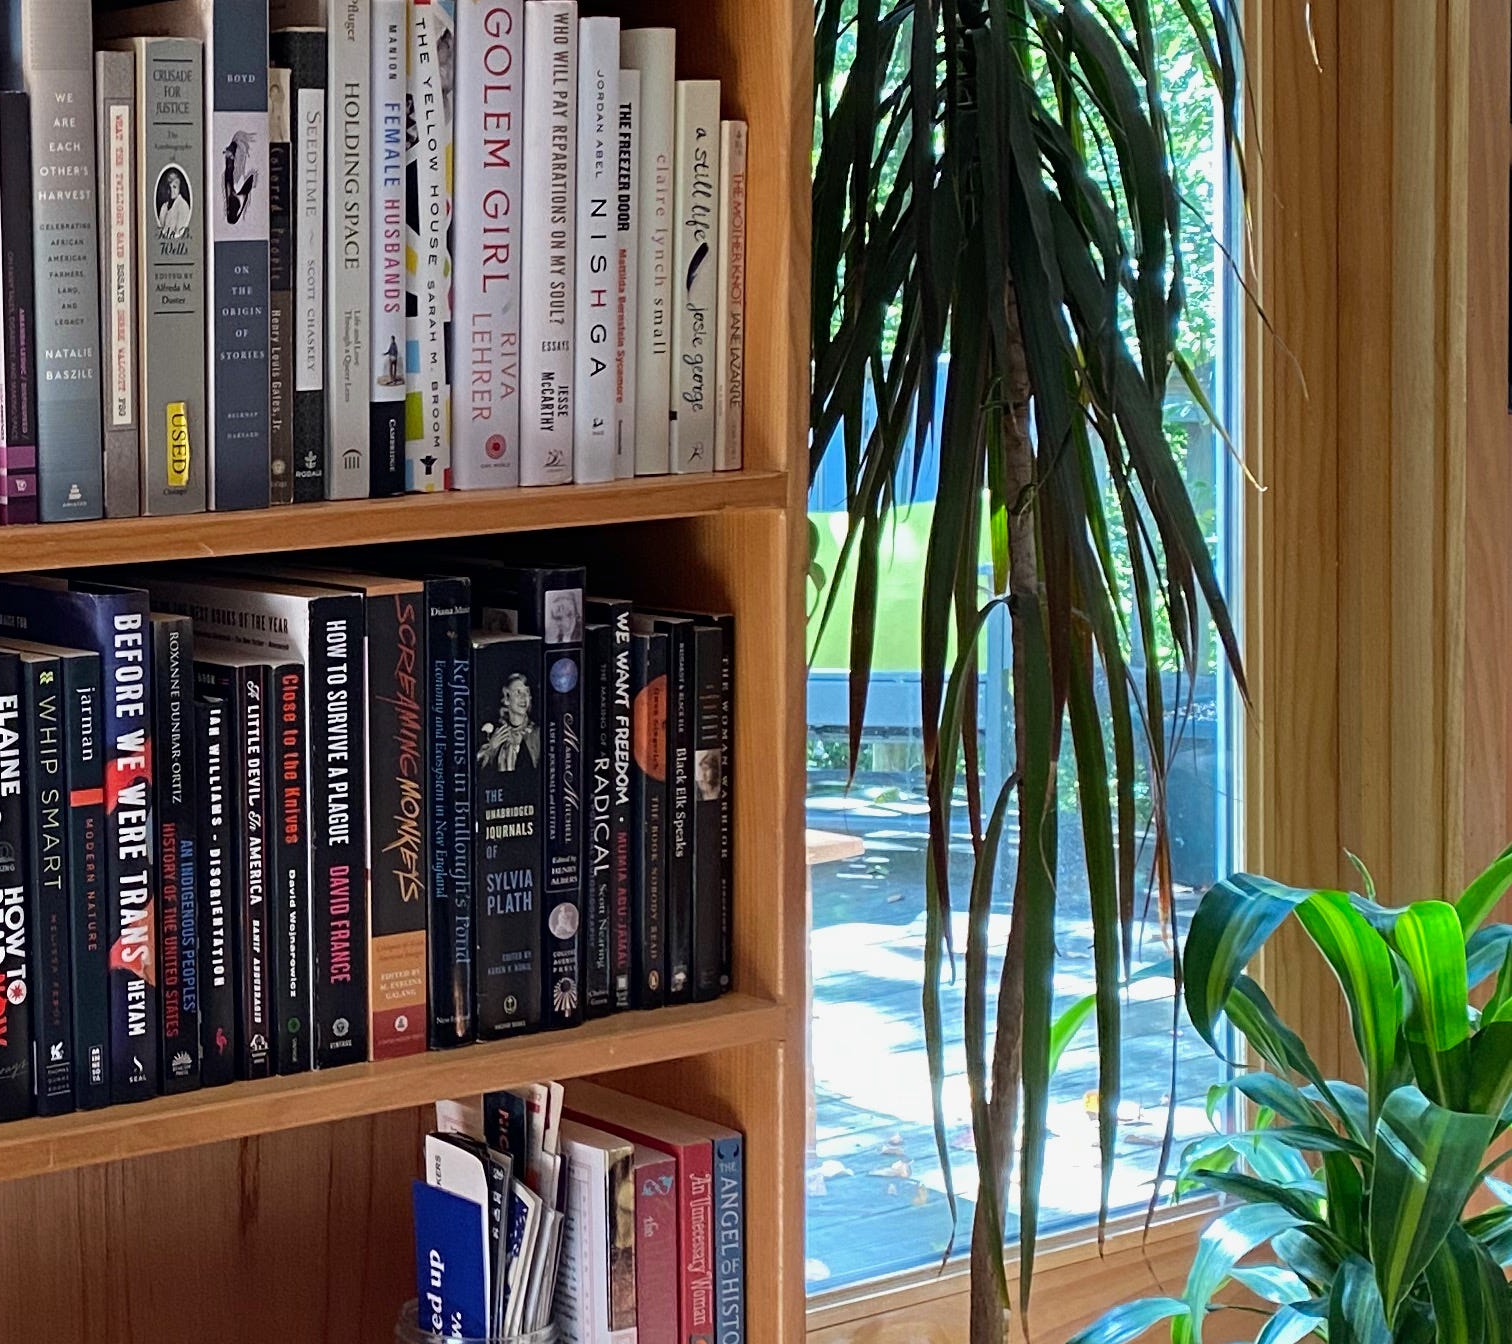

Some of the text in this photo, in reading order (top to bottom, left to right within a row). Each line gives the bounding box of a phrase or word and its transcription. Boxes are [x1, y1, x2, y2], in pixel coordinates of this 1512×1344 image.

[384, 103, 401, 313] FEMALE HUSBANDS
[482, 7, 512, 294] GOLEM GIRL
[617, 102, 632, 231] THE FREEZER DOOR
[170, 412, 187, 475] USED
[557, 385, 569, 416] JESSE
[78, 687, 97, 762] jarman
[326, 620, 350, 845] HOW TO SURVIVE A PLAGUE
[615, 612, 630, 804] WE WANT FREEDOM
[39, 695, 61, 890] WHIP SMART
[114, 614, 150, 963] BEFORE WE WERE TRANS
[593, 757, 610, 876] RADICAL
[3, 886, 24, 956] HOW
[128, 980, 146, 1036] HEYAM
[721, 1176, 738, 1256] ANGEL
